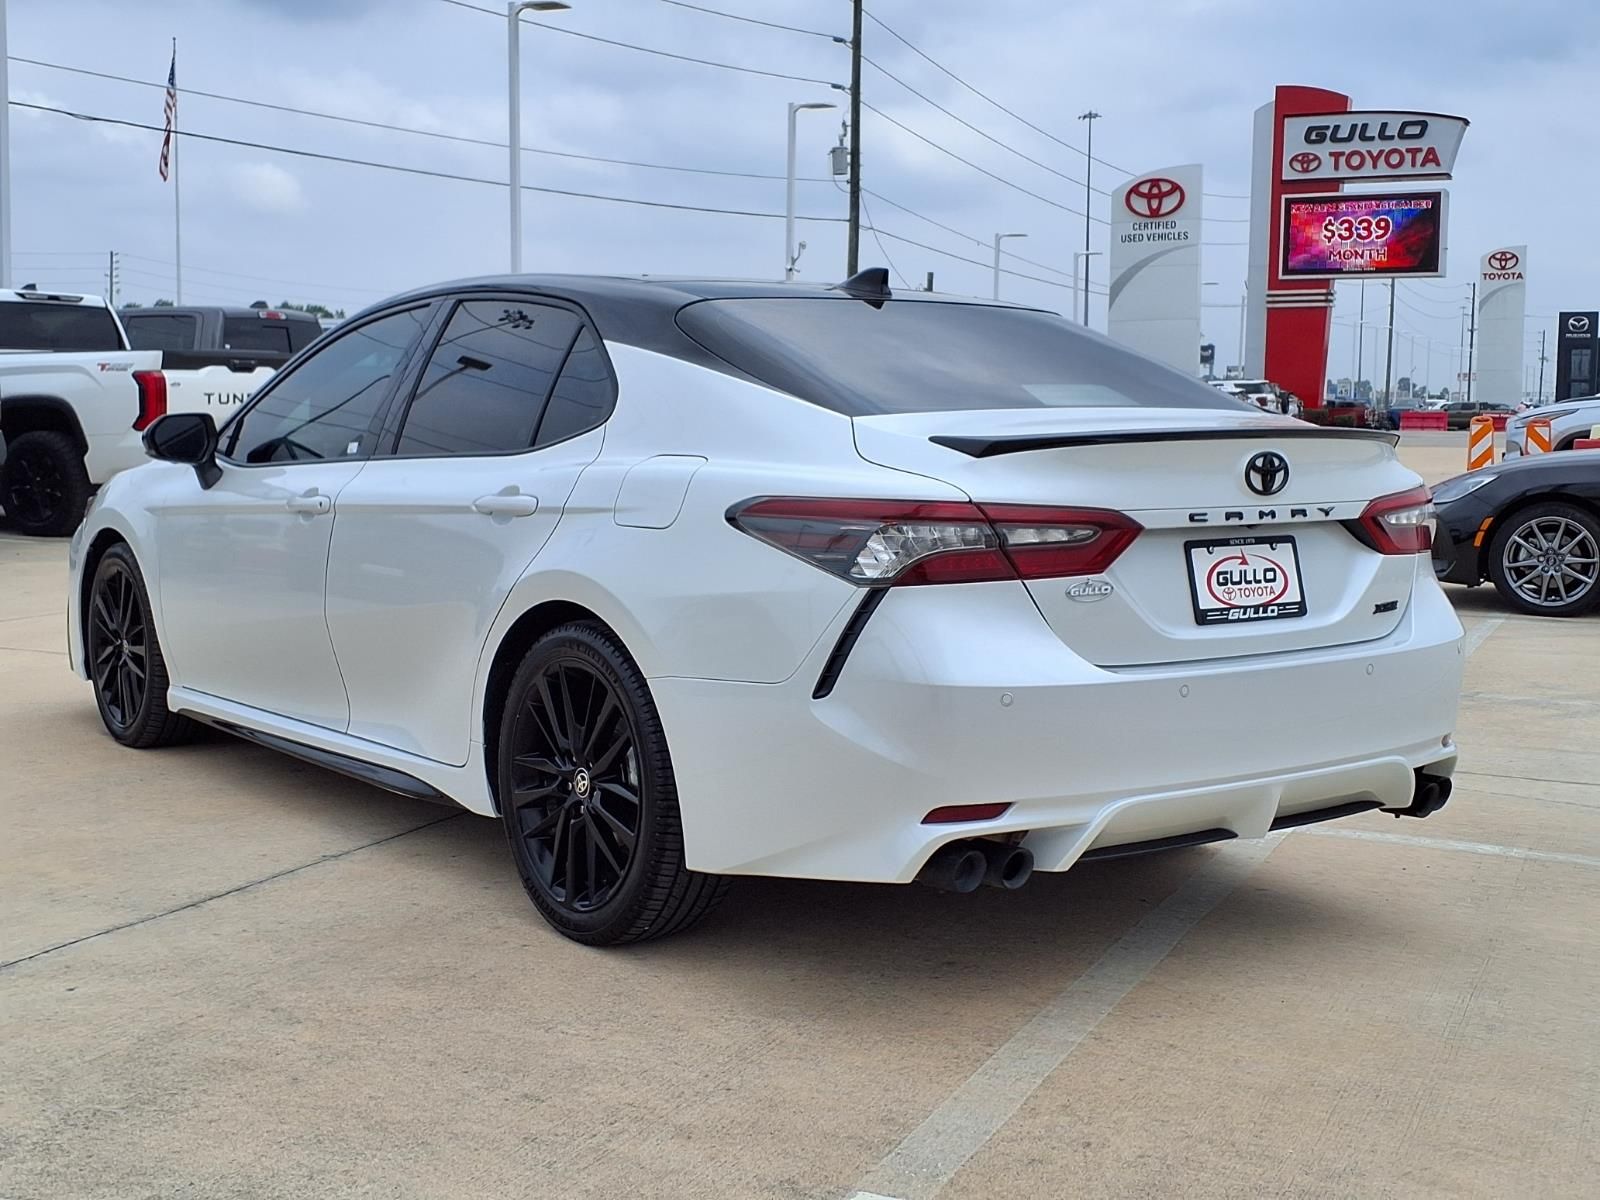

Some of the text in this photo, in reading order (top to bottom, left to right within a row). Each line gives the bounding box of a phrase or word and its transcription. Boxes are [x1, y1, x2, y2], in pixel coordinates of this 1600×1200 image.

[1304, 119, 1428, 145] GULLO
[1328, 146, 1441, 171] TOYOTA
[1132, 220, 1177, 231] CERTIFIED
[1322, 216, 1392, 245] $339
[1120, 231, 1189, 243] USED VEHICLES
[1328, 247, 1388, 261] MONTH
[1482, 271, 1524, 280] TOYOTA
[203, 392, 251, 405] TUN
[1188, 506, 1335, 523] CAMRY
[1216, 567, 1277, 587] GULLO
[1070, 585, 1112, 596] GULLO
[1237, 585, 1276, 599] TOYOTA
[1228, 606, 1278, 620] GULLO
